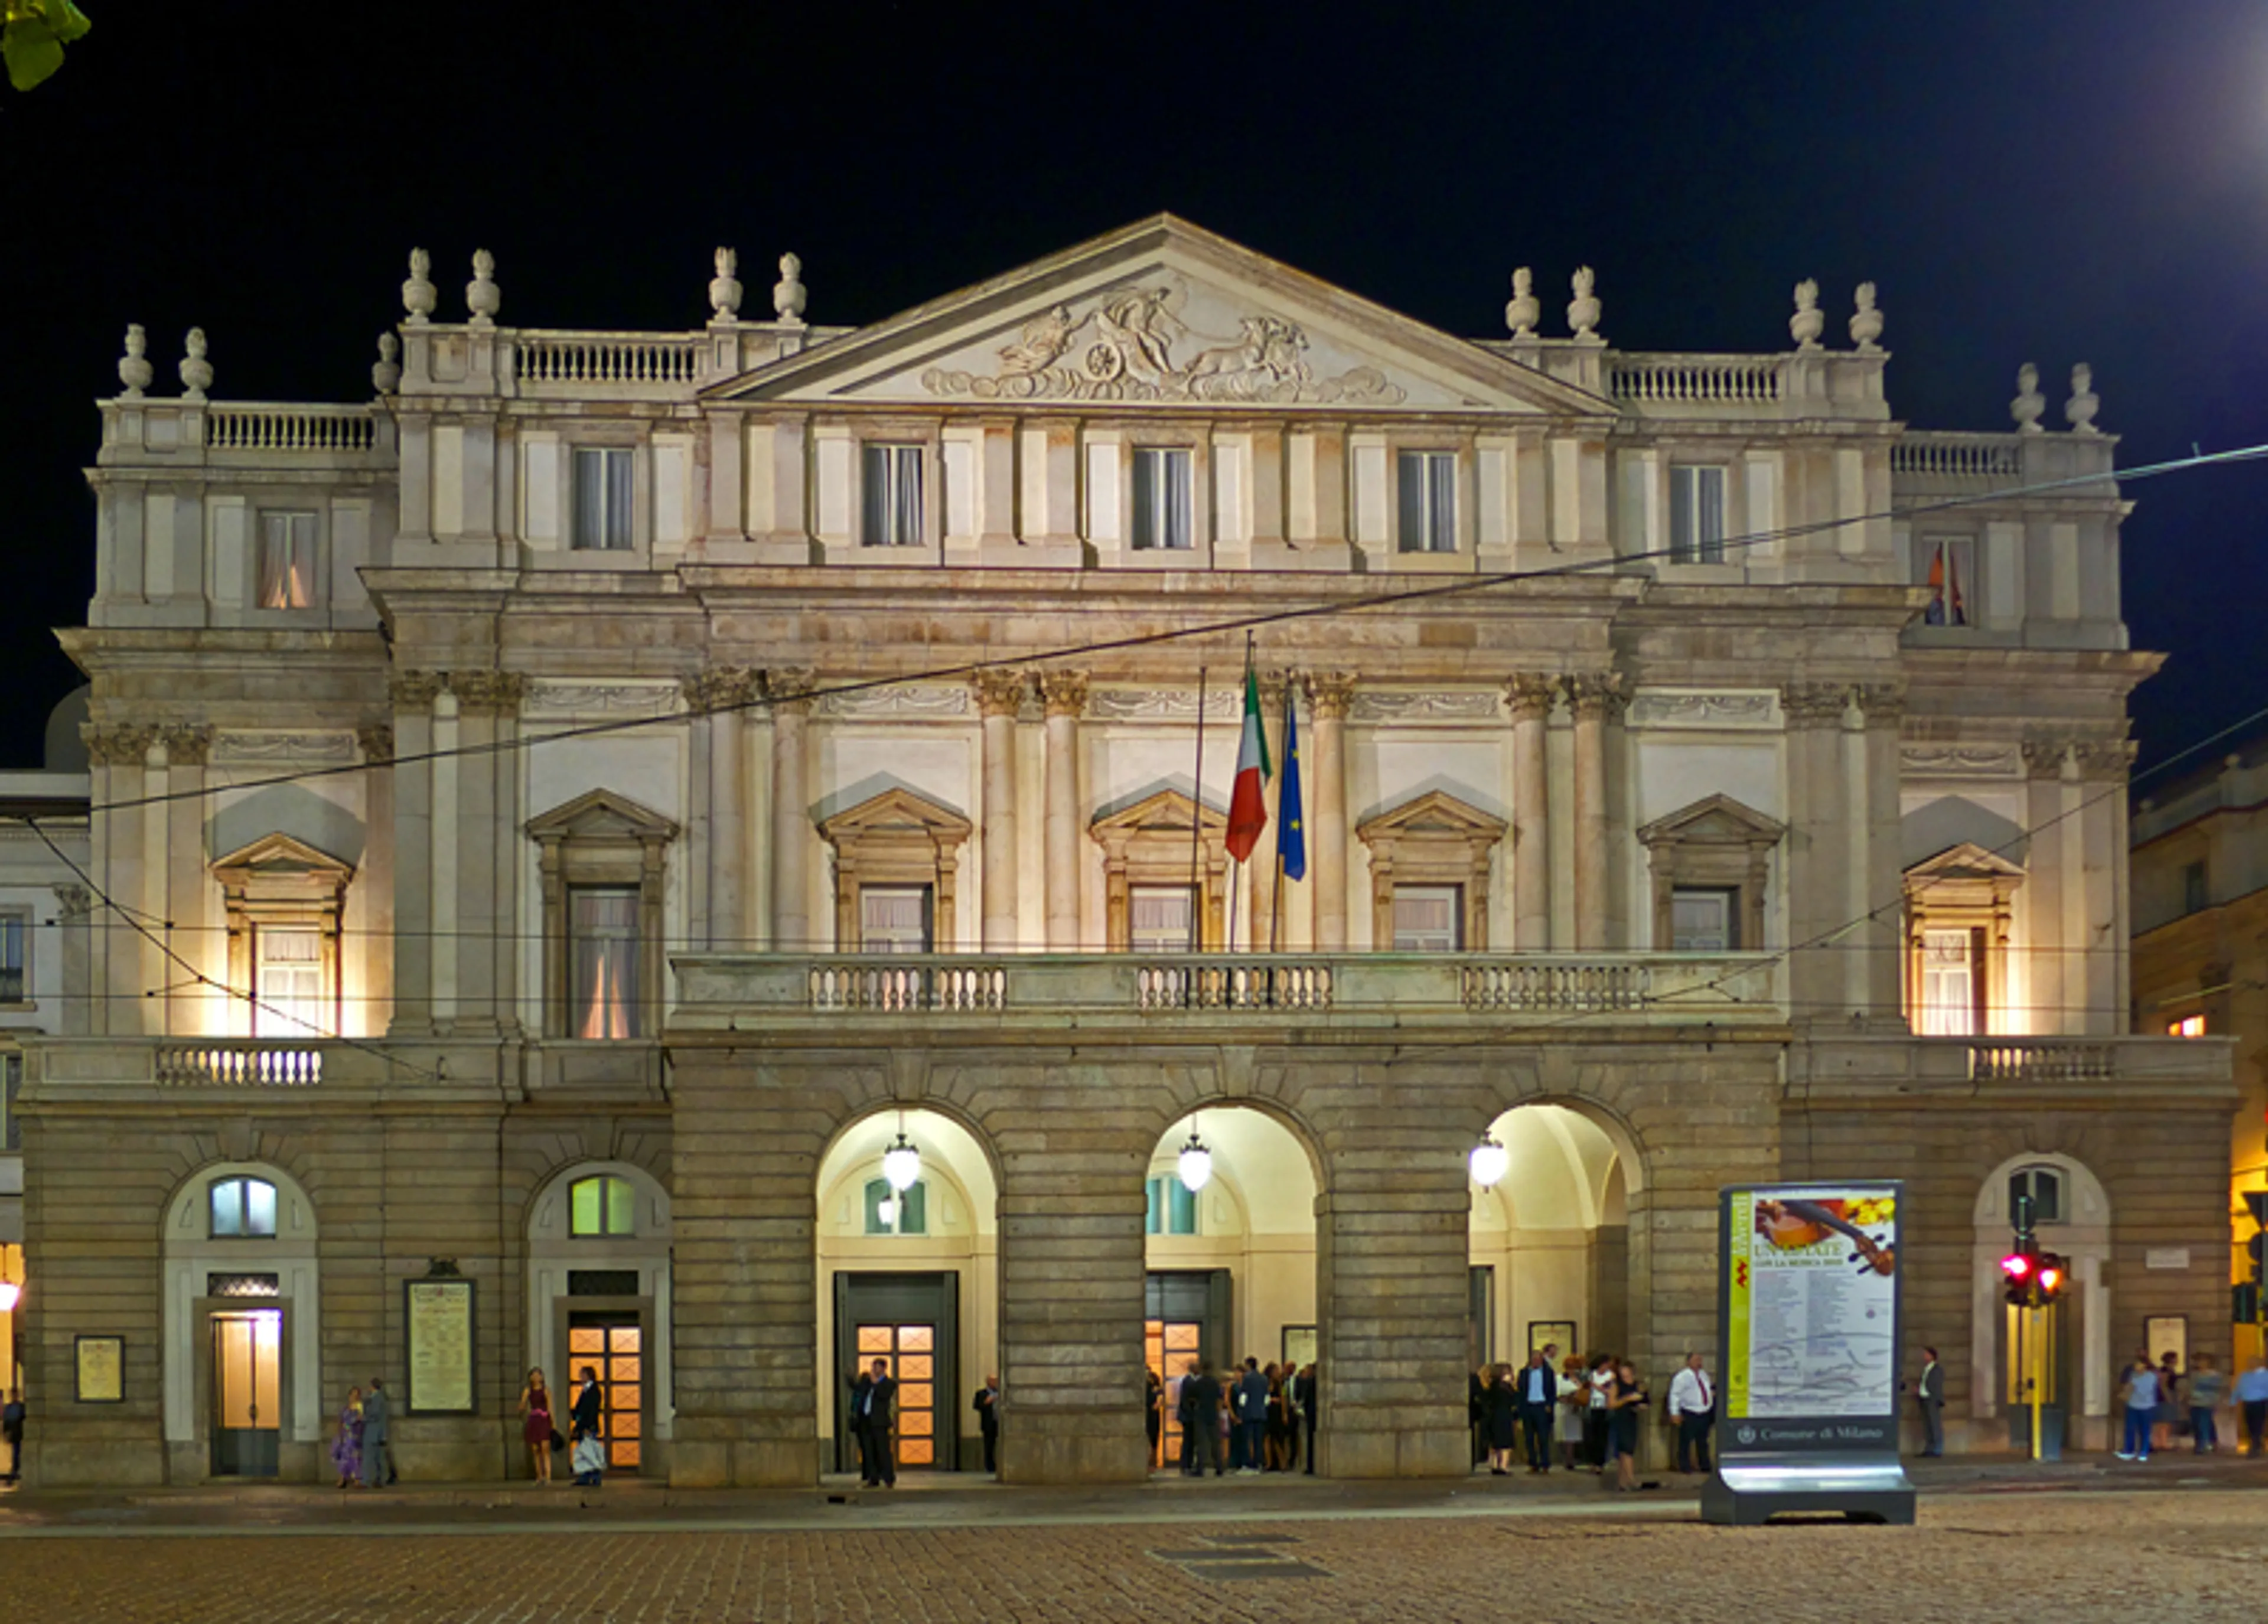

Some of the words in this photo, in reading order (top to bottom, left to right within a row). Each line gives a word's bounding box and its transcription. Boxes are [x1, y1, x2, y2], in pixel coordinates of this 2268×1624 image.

[1760, 1427, 1817, 1440] Comune
[1820, 1427, 1833, 1439] di
[1836, 1426, 1884, 1439] Milano
